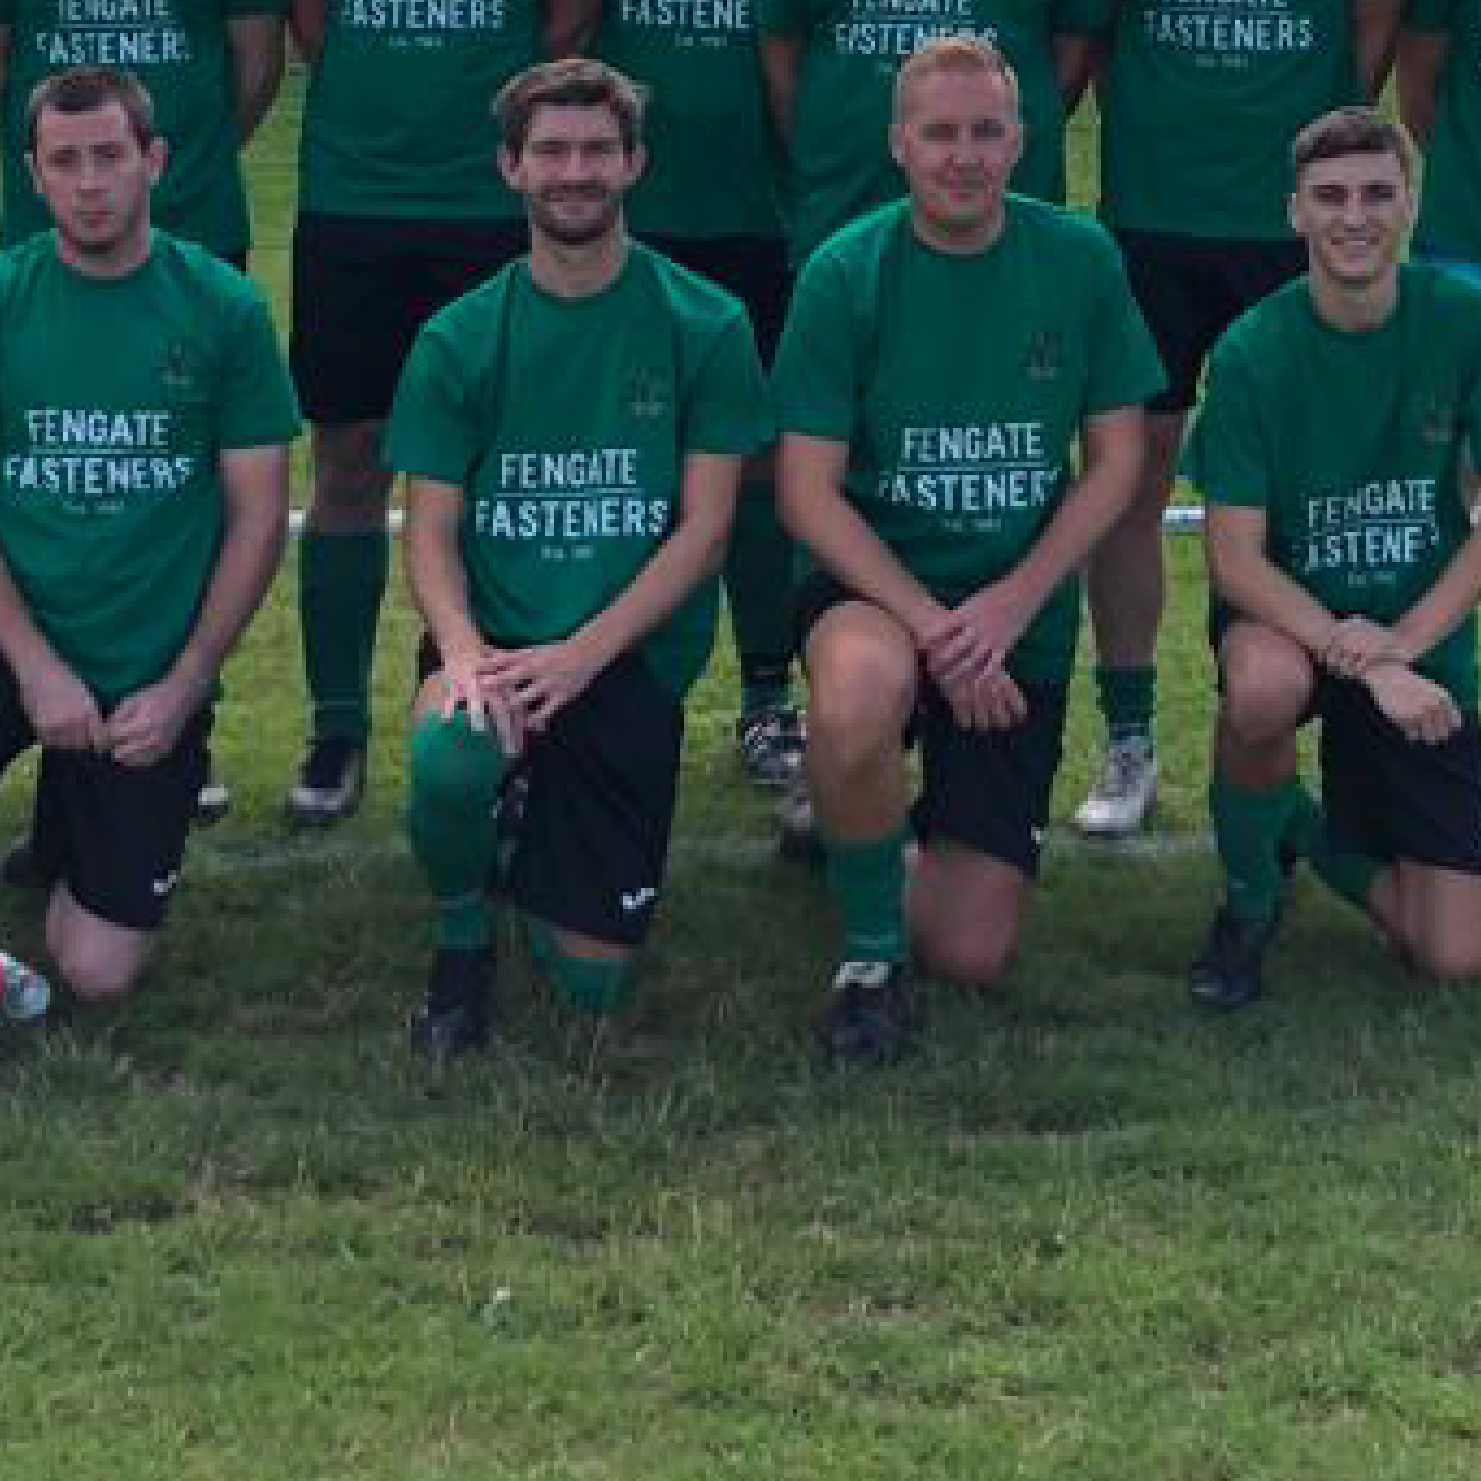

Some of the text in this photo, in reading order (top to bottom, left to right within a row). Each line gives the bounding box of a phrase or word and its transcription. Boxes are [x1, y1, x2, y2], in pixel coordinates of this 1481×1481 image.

[25, 410, 169, 446] FENGATE
[903, 423, 1044, 462] FENGATE
[4, 454, 194, 494] FASTENERS
[501, 449, 636, 487] FENGATE
[878, 471, 1058, 511] ASTENER
[1308, 480, 1436, 528] FENGATE
[475, 497, 671, 537] FASTENERS
[1304, 525, 1438, 572] ASTENE
